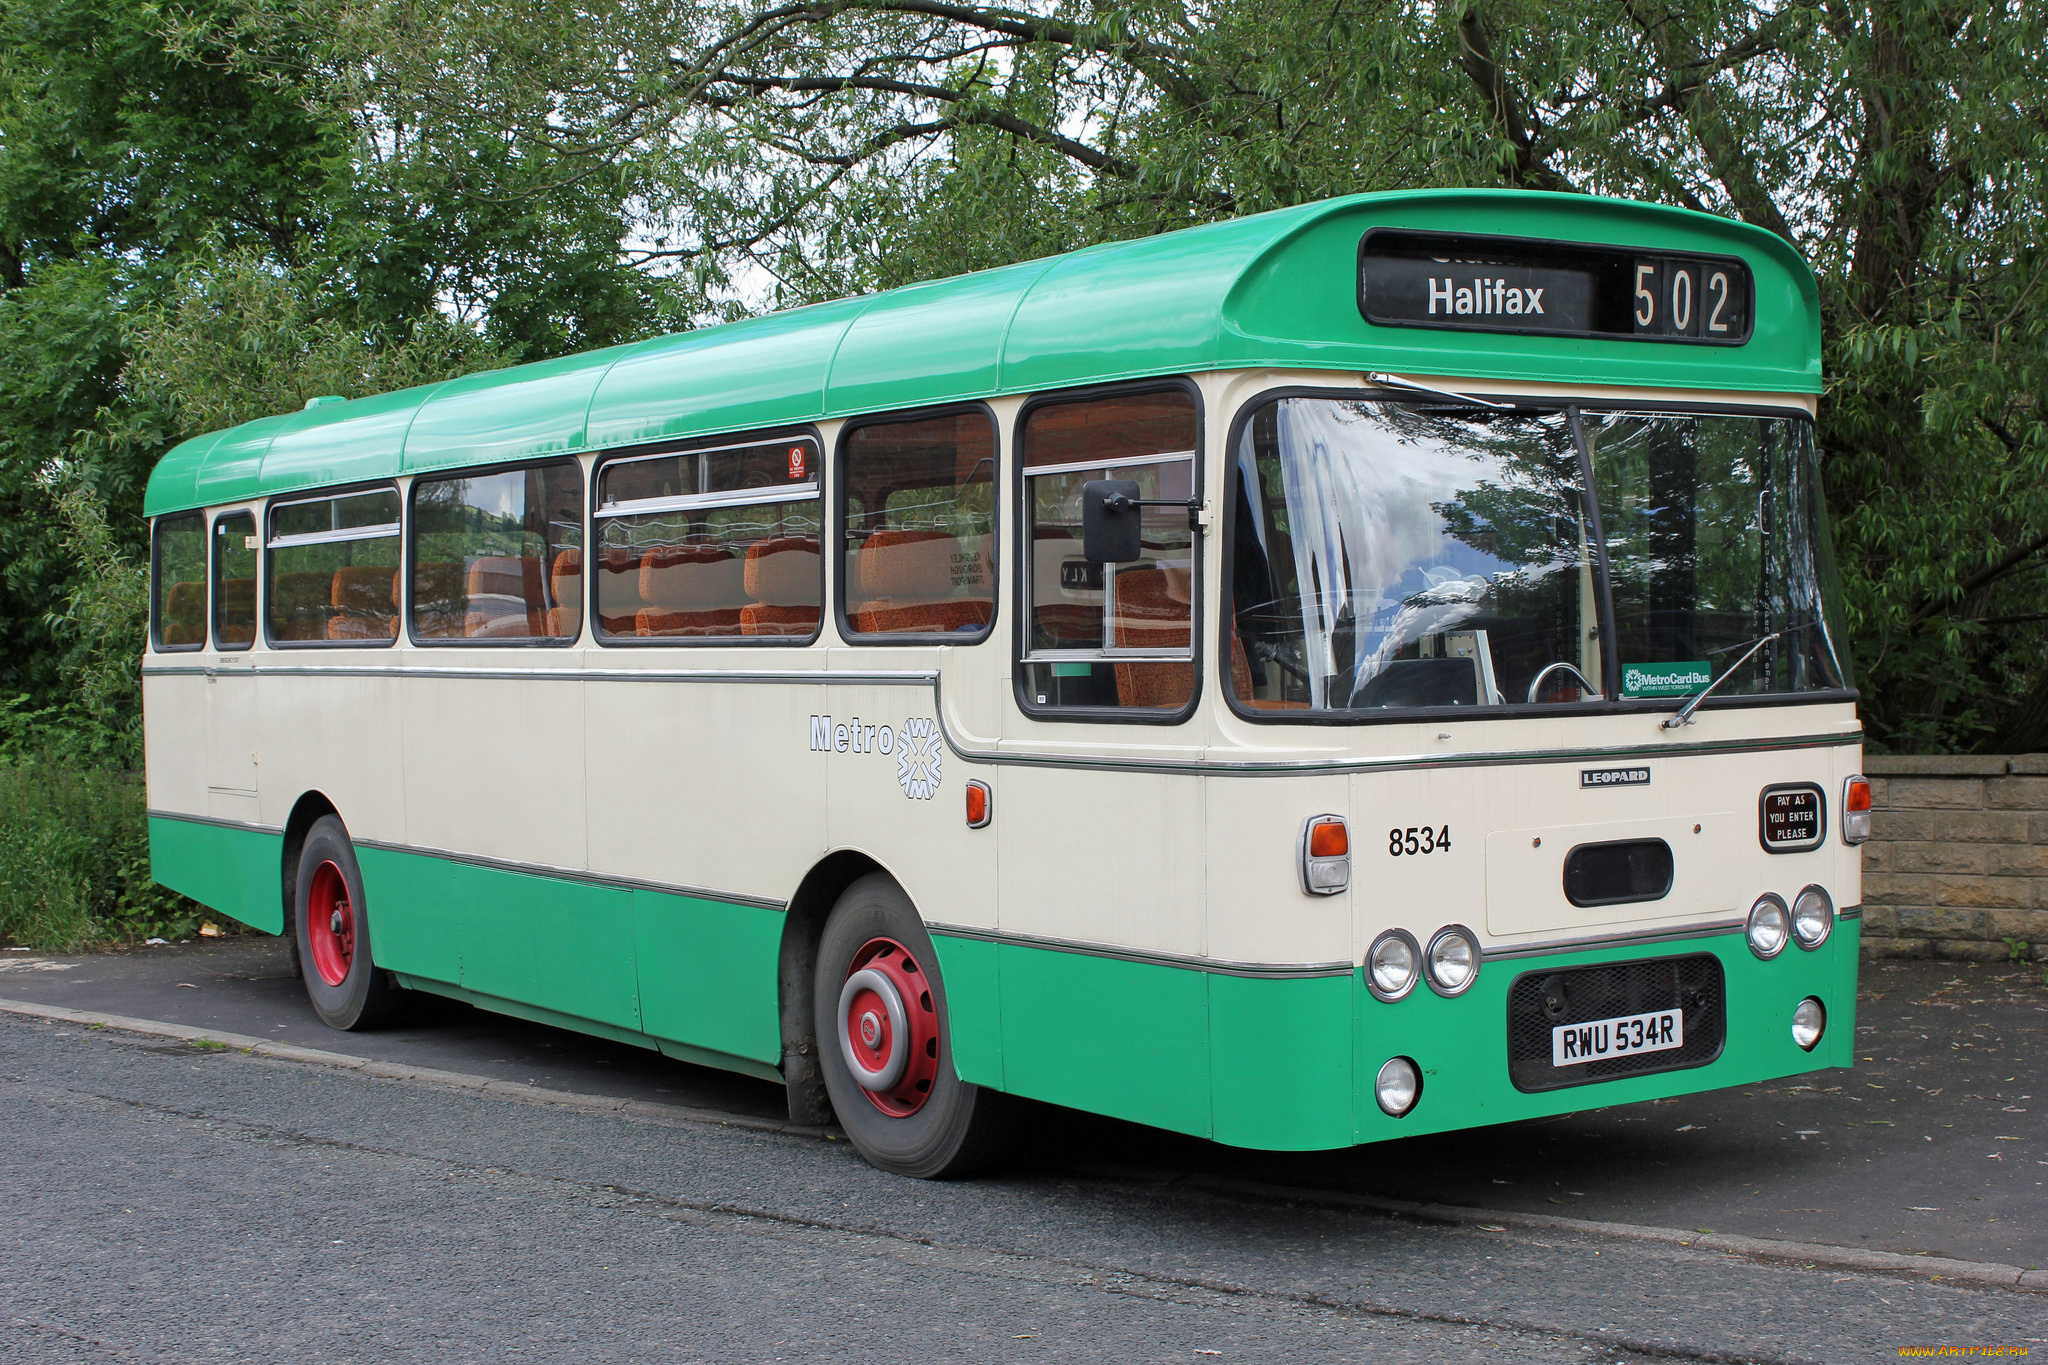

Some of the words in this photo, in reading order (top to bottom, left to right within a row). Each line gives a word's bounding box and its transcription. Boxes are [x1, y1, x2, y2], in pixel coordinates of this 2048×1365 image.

[1428, 277, 1545, 315] Halifax
[1635, 265, 1729, 332] 502
[810, 715, 895, 755] Metro
[1583, 770, 1649, 784] LEOPARD
[1769, 812, 1785, 823] YOU
[1789, 811, 1814, 822] ENTER
[1777, 795, 1790, 806] PAY
[1794, 795, 1806, 806] AS
[1388, 824, 1452, 857] 8534
[1777, 828, 1807, 840] PLEASE
[1563, 1024, 1609, 1059] RWU
[1615, 1015, 1674, 1051] 534R
